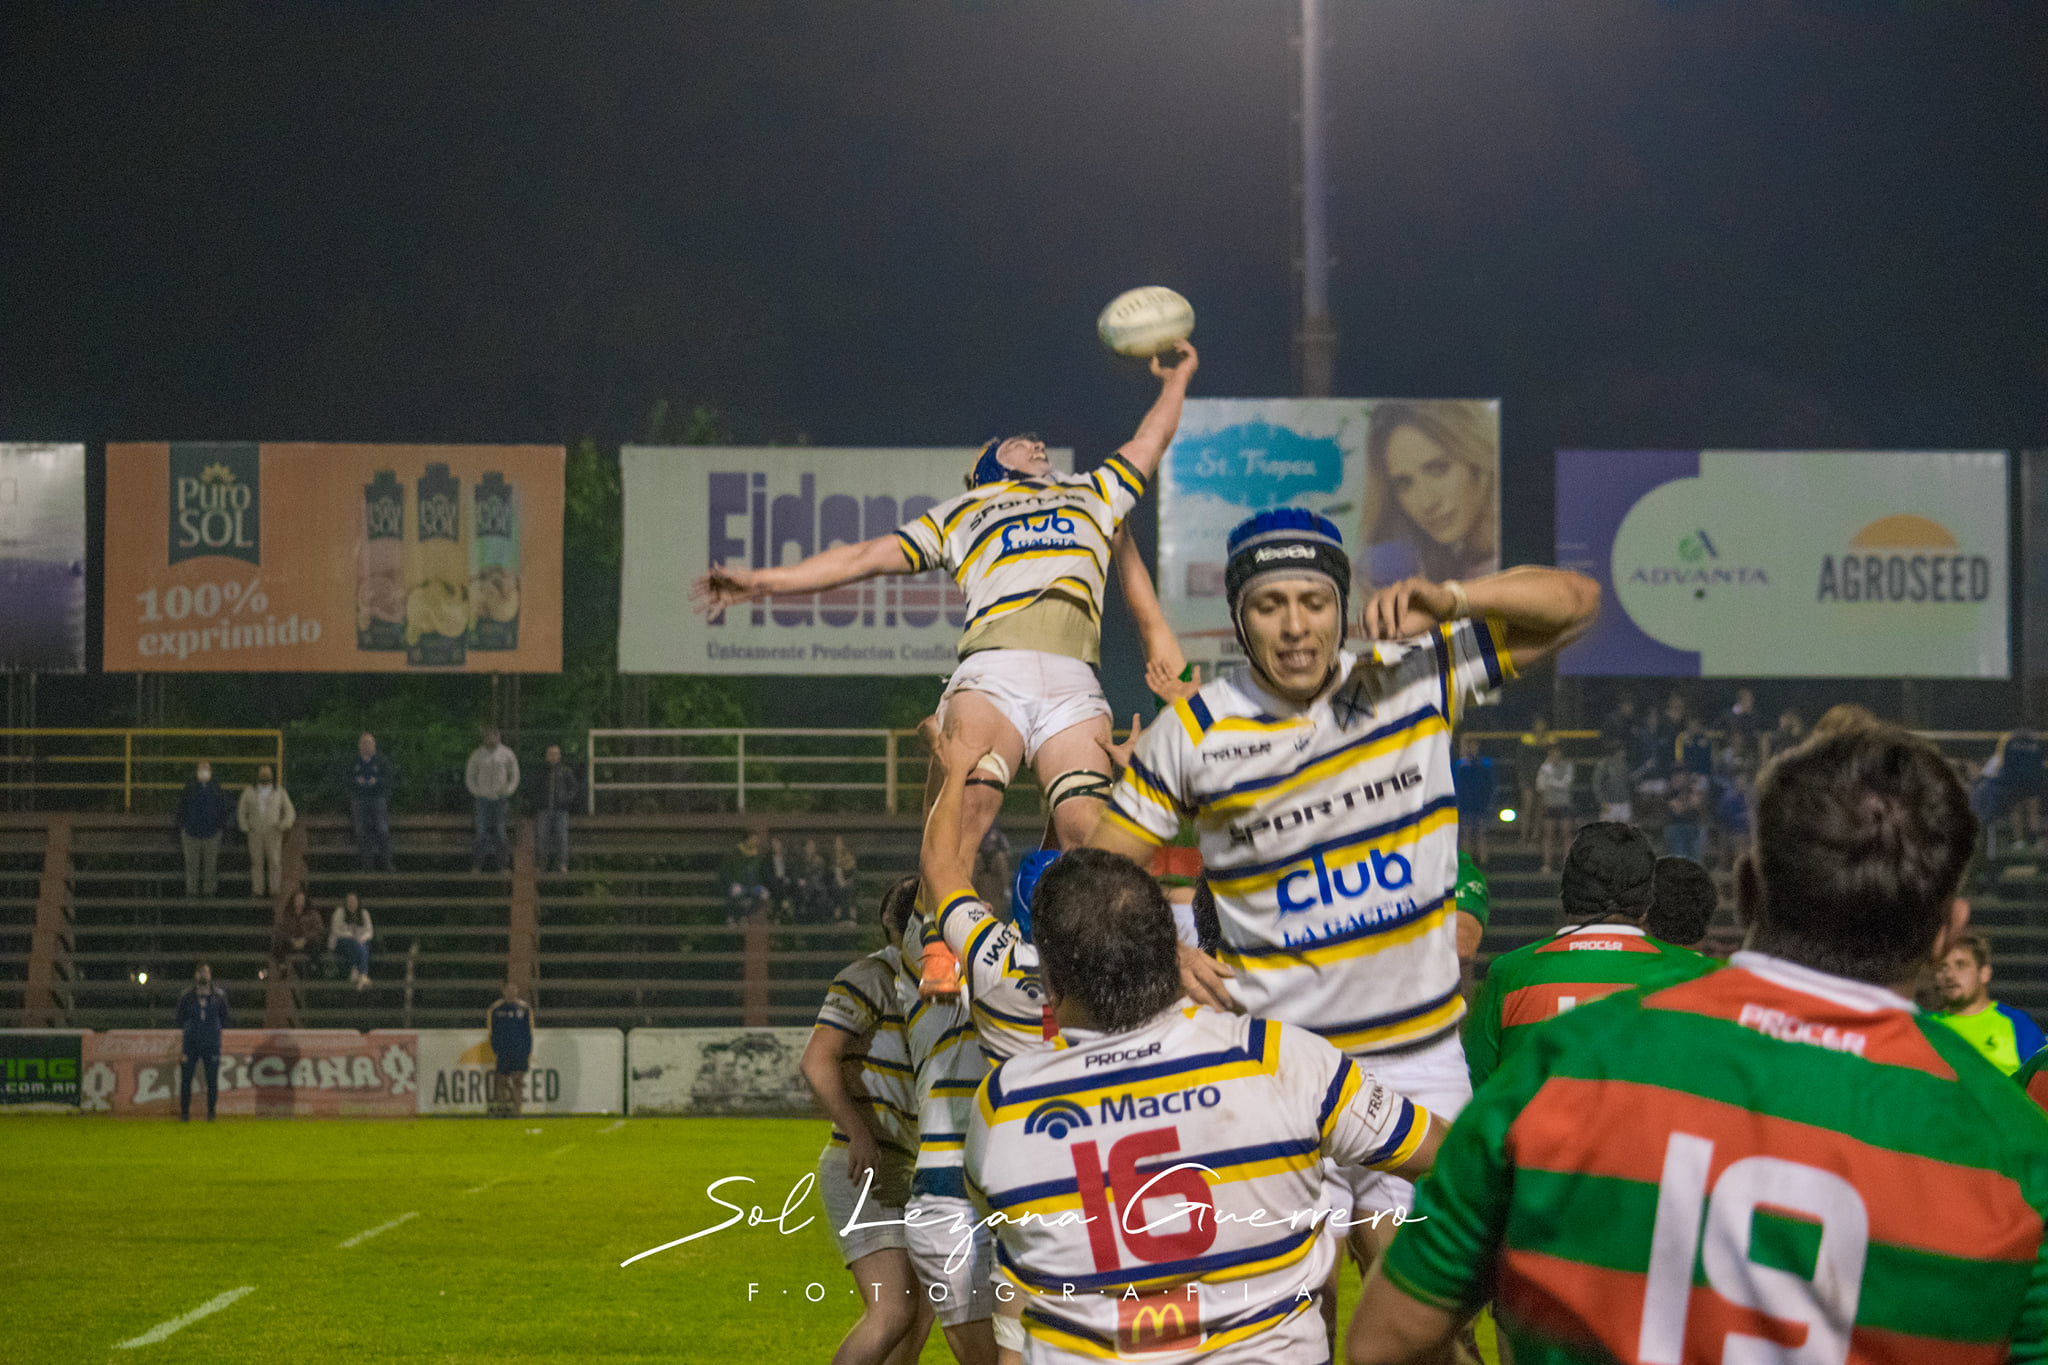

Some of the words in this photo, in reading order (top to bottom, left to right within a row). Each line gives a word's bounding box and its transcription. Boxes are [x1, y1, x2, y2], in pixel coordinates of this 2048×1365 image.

[177, 476, 252, 511] Puro
[179, 508, 254, 548] SOL
[1629, 566, 1769, 586] ADVANTA
[1818, 554, 1991, 603] AGROSEED
[136, 577, 269, 624] 100%
[137, 615, 322, 662] exprimido
[1228, 763, 1423, 849] SPORTING
[1276, 847, 1413, 916] club
[1569, 941, 1623, 952] PROCER
[1738, 1003, 1868, 1058] PROCER
[0, 1058, 76, 1079] ING
[1085, 1041, 1162, 1069] PROCER
[1100, 1085, 1221, 1125] Macro
[1070, 1127, 1217, 1273] 16
[1638, 1131, 1869, 1364] 19
